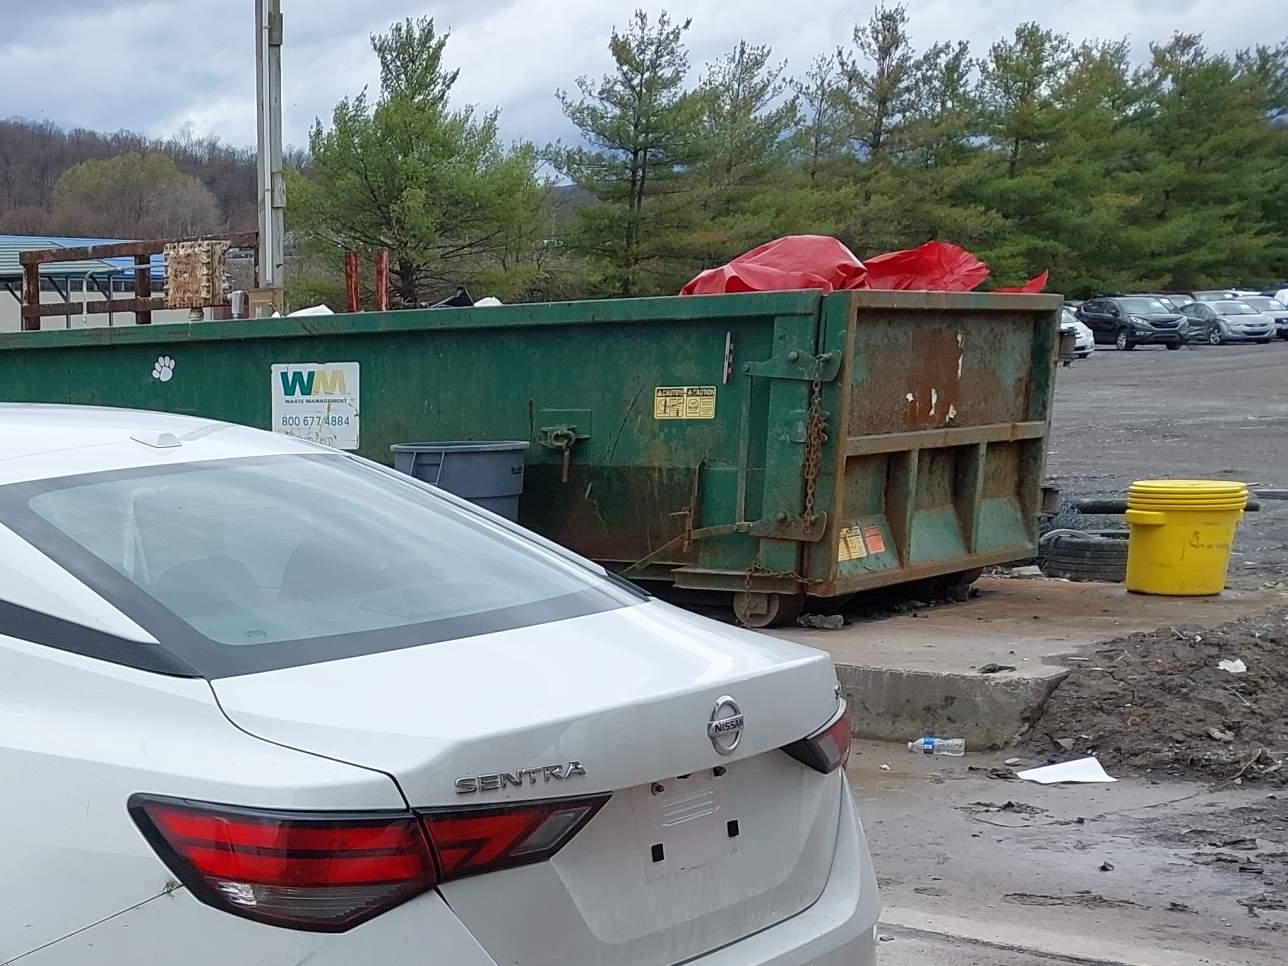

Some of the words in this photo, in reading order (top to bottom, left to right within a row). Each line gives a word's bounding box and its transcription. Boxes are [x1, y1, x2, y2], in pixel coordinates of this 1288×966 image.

[280, 370, 346, 396] WM
[693, 388, 715, 396] CAUTION
[281, 416, 300, 427] 800
[303, 416, 321, 427] 677
[325, 415, 350, 426] 4884
[714, 718, 744, 733] NISSAN
[454, 760, 586, 794] SENTRA
